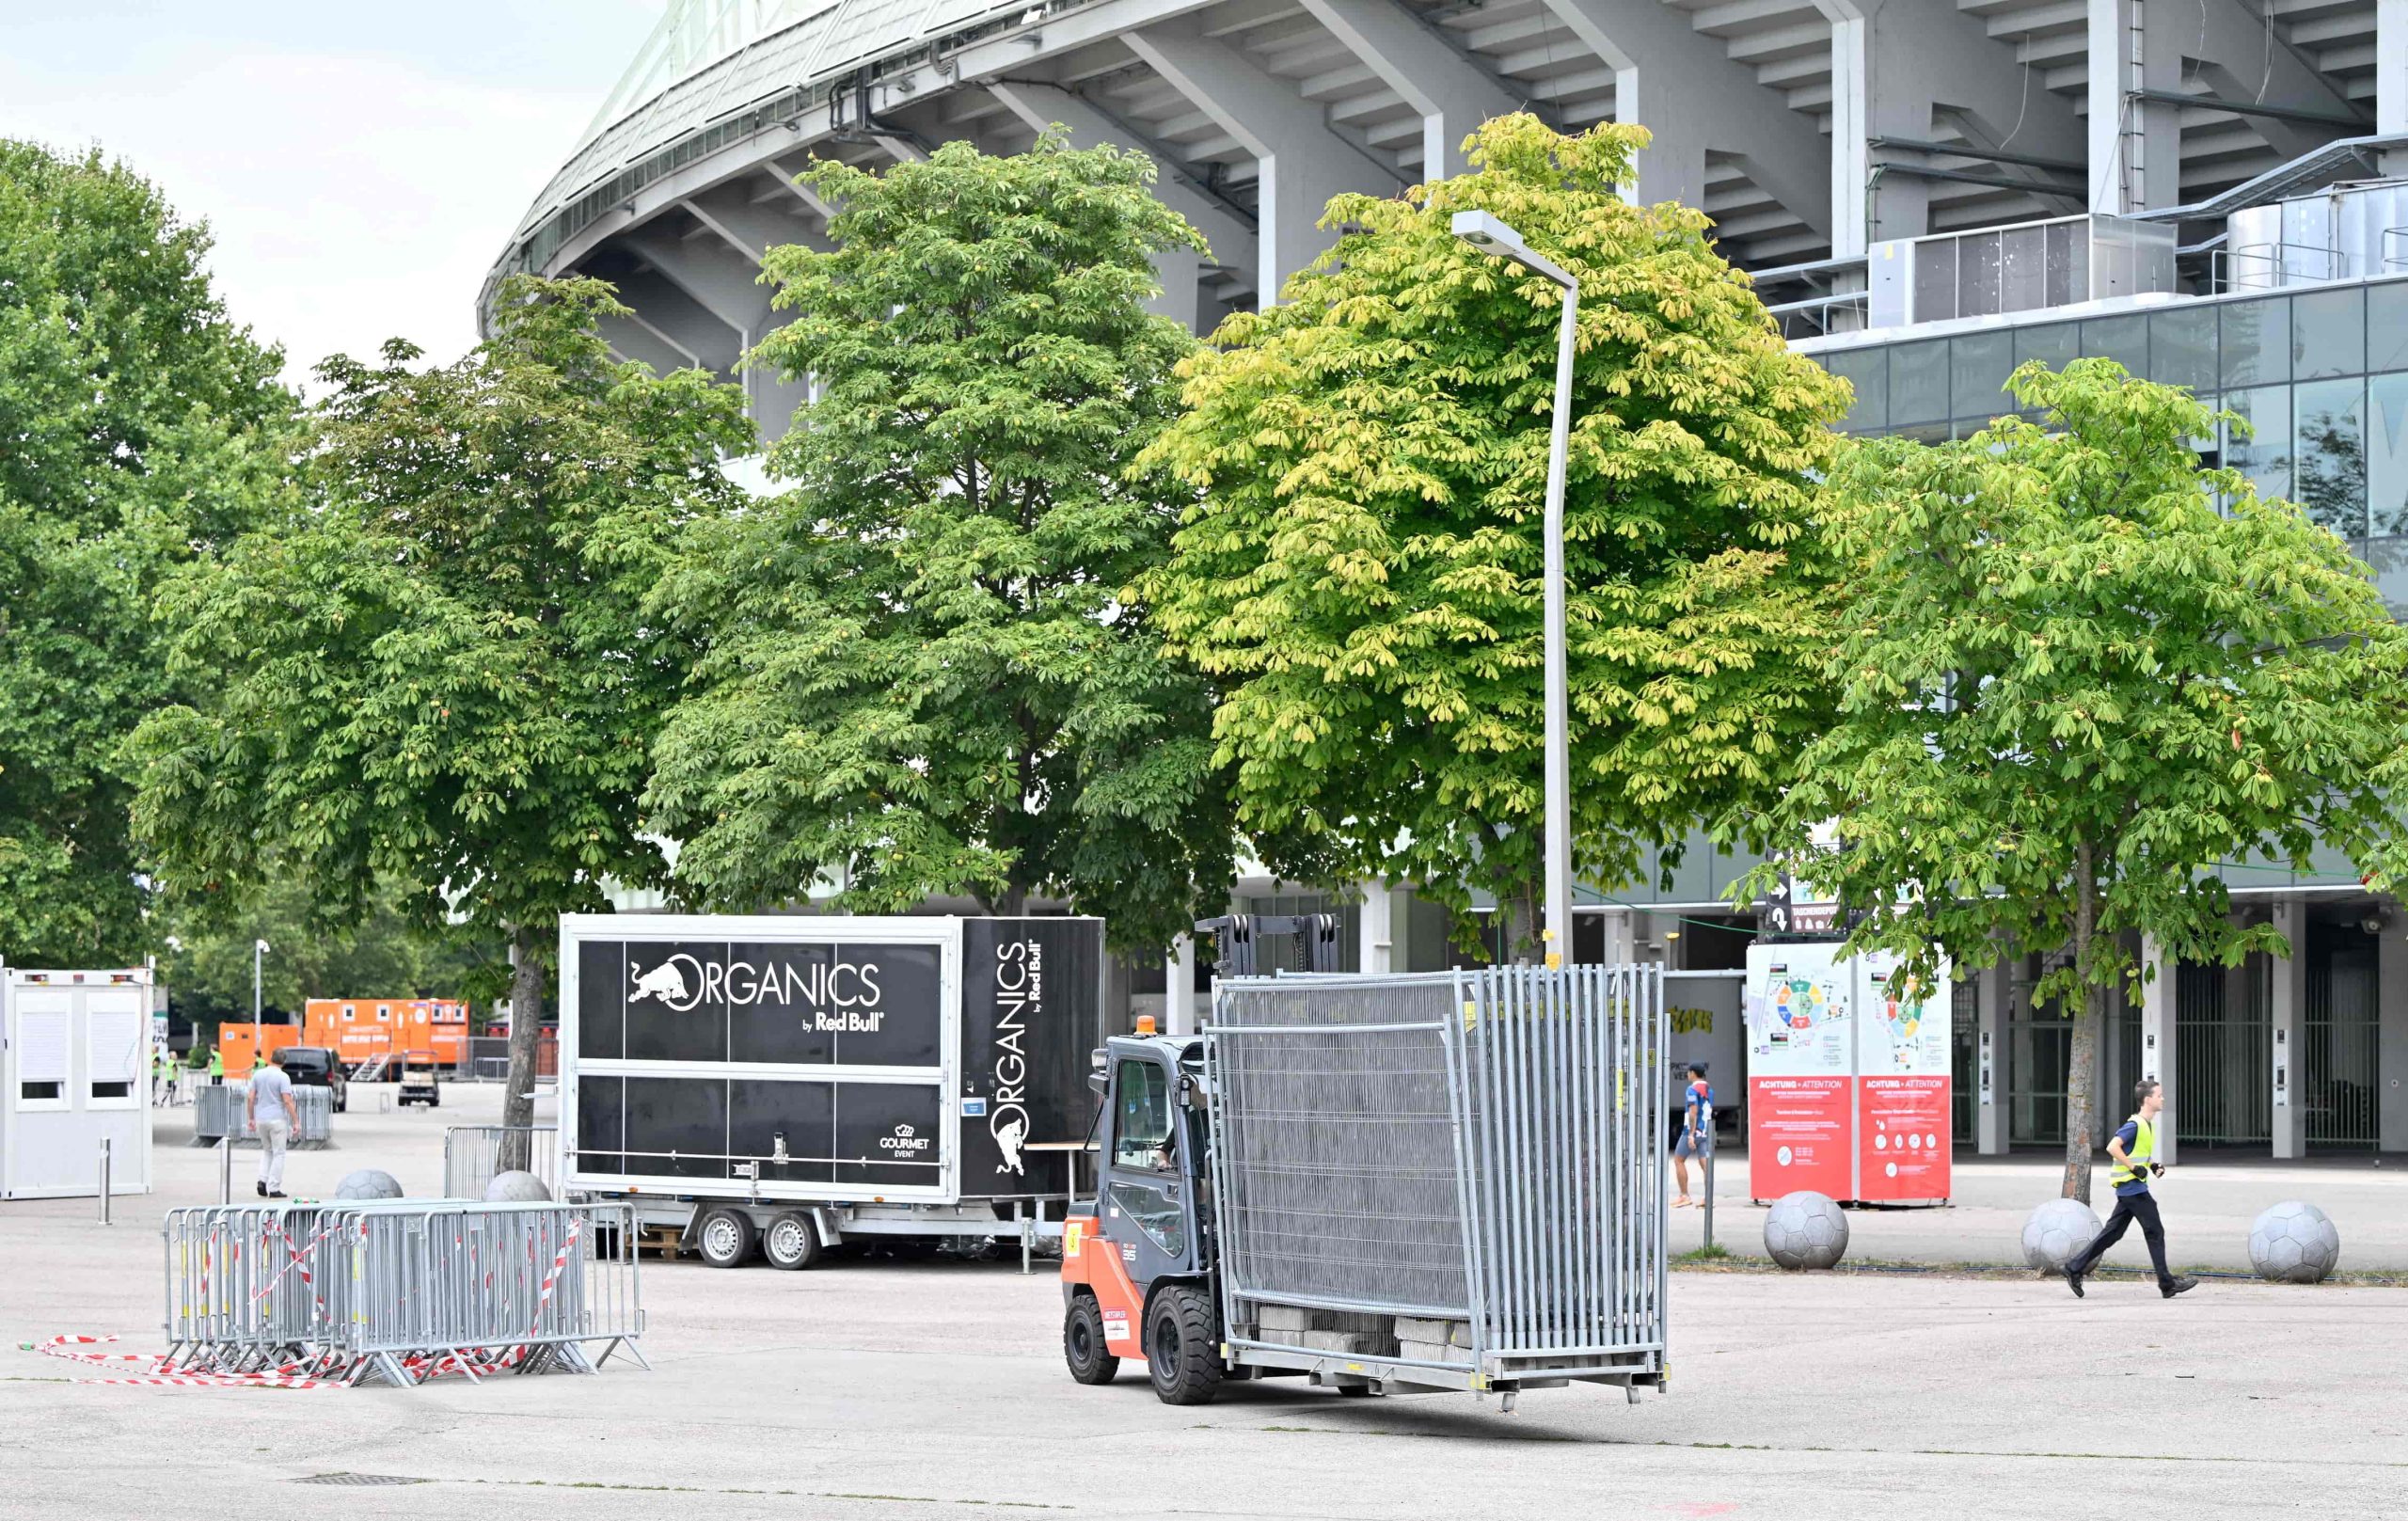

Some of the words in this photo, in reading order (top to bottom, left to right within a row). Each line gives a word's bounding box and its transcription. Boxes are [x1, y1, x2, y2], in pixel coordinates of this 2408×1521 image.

[664, 954, 880, 1011] ORGANICS
[1028, 973, 1040, 1001] Red
[1034, 1004, 1041, 1013] by
[802, 1020, 812, 1033] by
[816, 1012, 847, 1031] Red
[990, 943, 1030, 1142] ORGANICS
[1759, 1081, 1797, 1089] ACHTUNG
[1802, 1080, 1842, 1089] ATTENTION
[1866, 1080, 1900, 1088] ACHTUNG
[1905, 1080, 1942, 1088] ATTENTION
[879, 1137, 929, 1149] GOURMET
[895, 1149, 915, 1158] EVENT
[1122, 1249, 1136, 1260] 35
